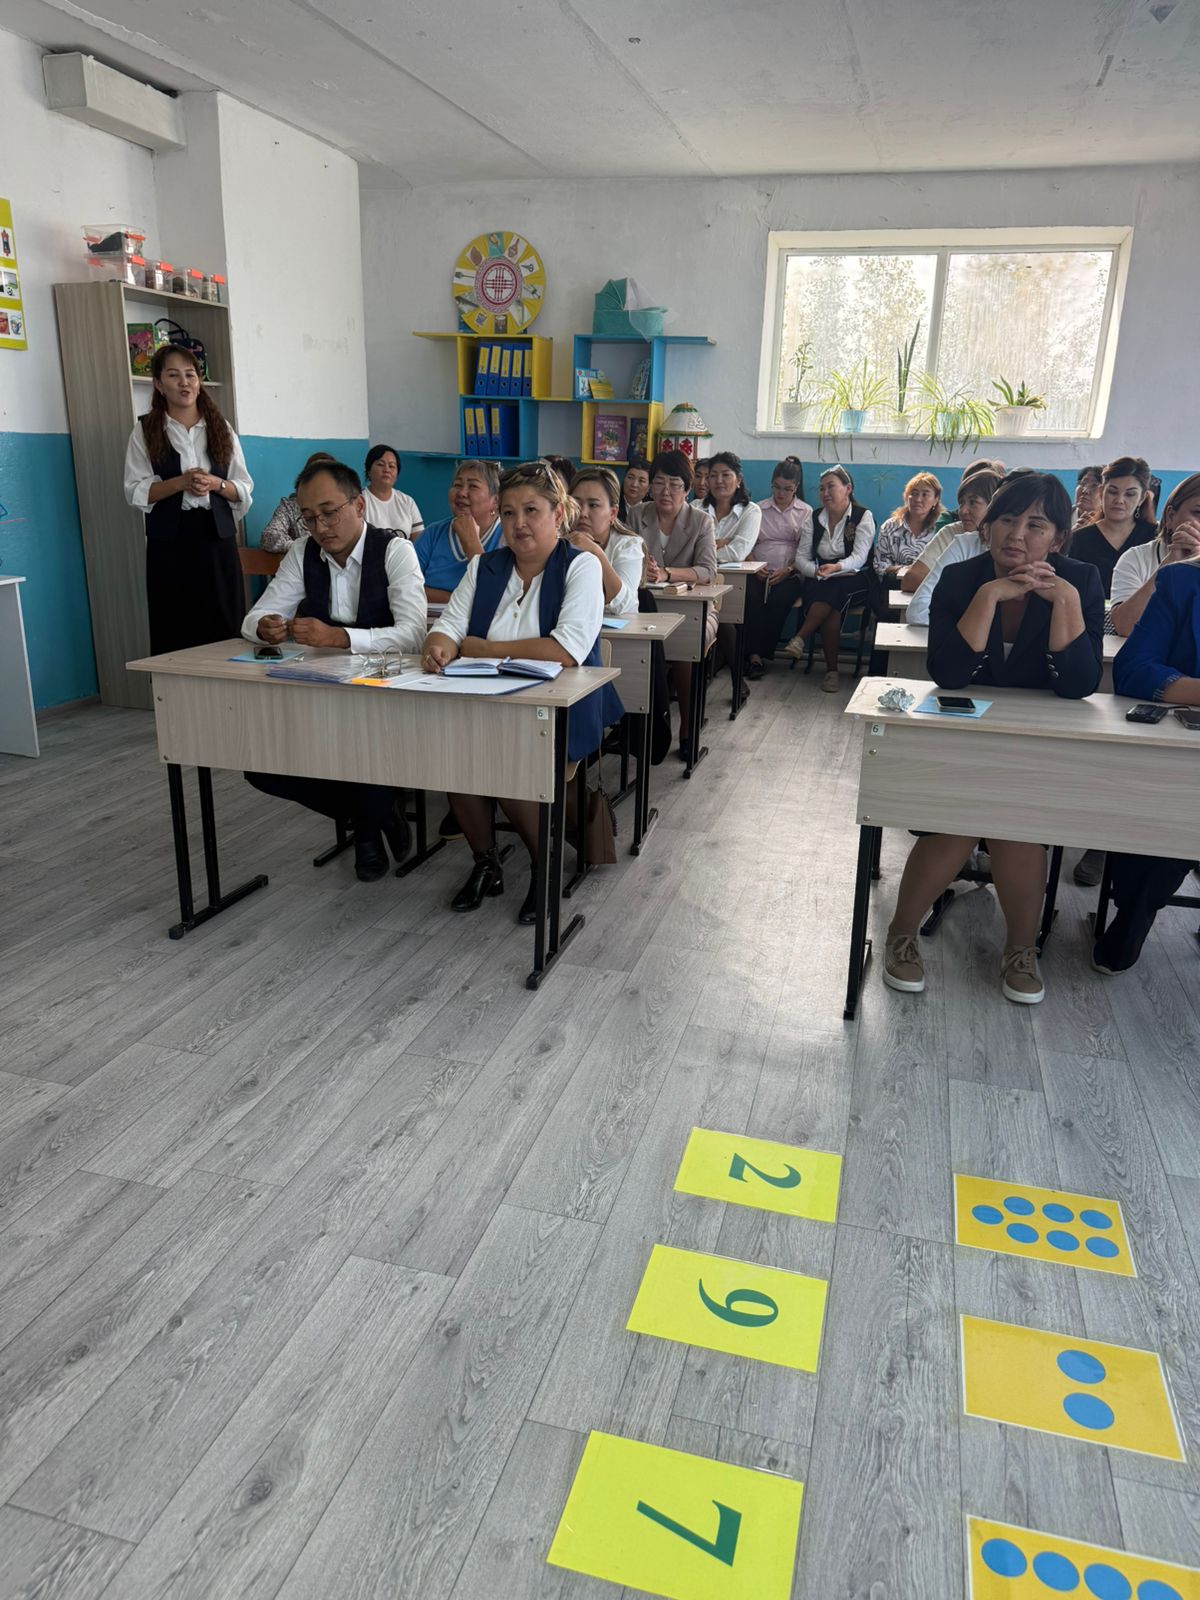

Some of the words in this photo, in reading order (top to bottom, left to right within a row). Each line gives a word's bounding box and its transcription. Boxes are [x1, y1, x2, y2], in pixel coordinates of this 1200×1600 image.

[728, 1153, 802, 1188] 2
[699, 1278, 779, 1327] 9
[637, 1500, 742, 1567] 7
